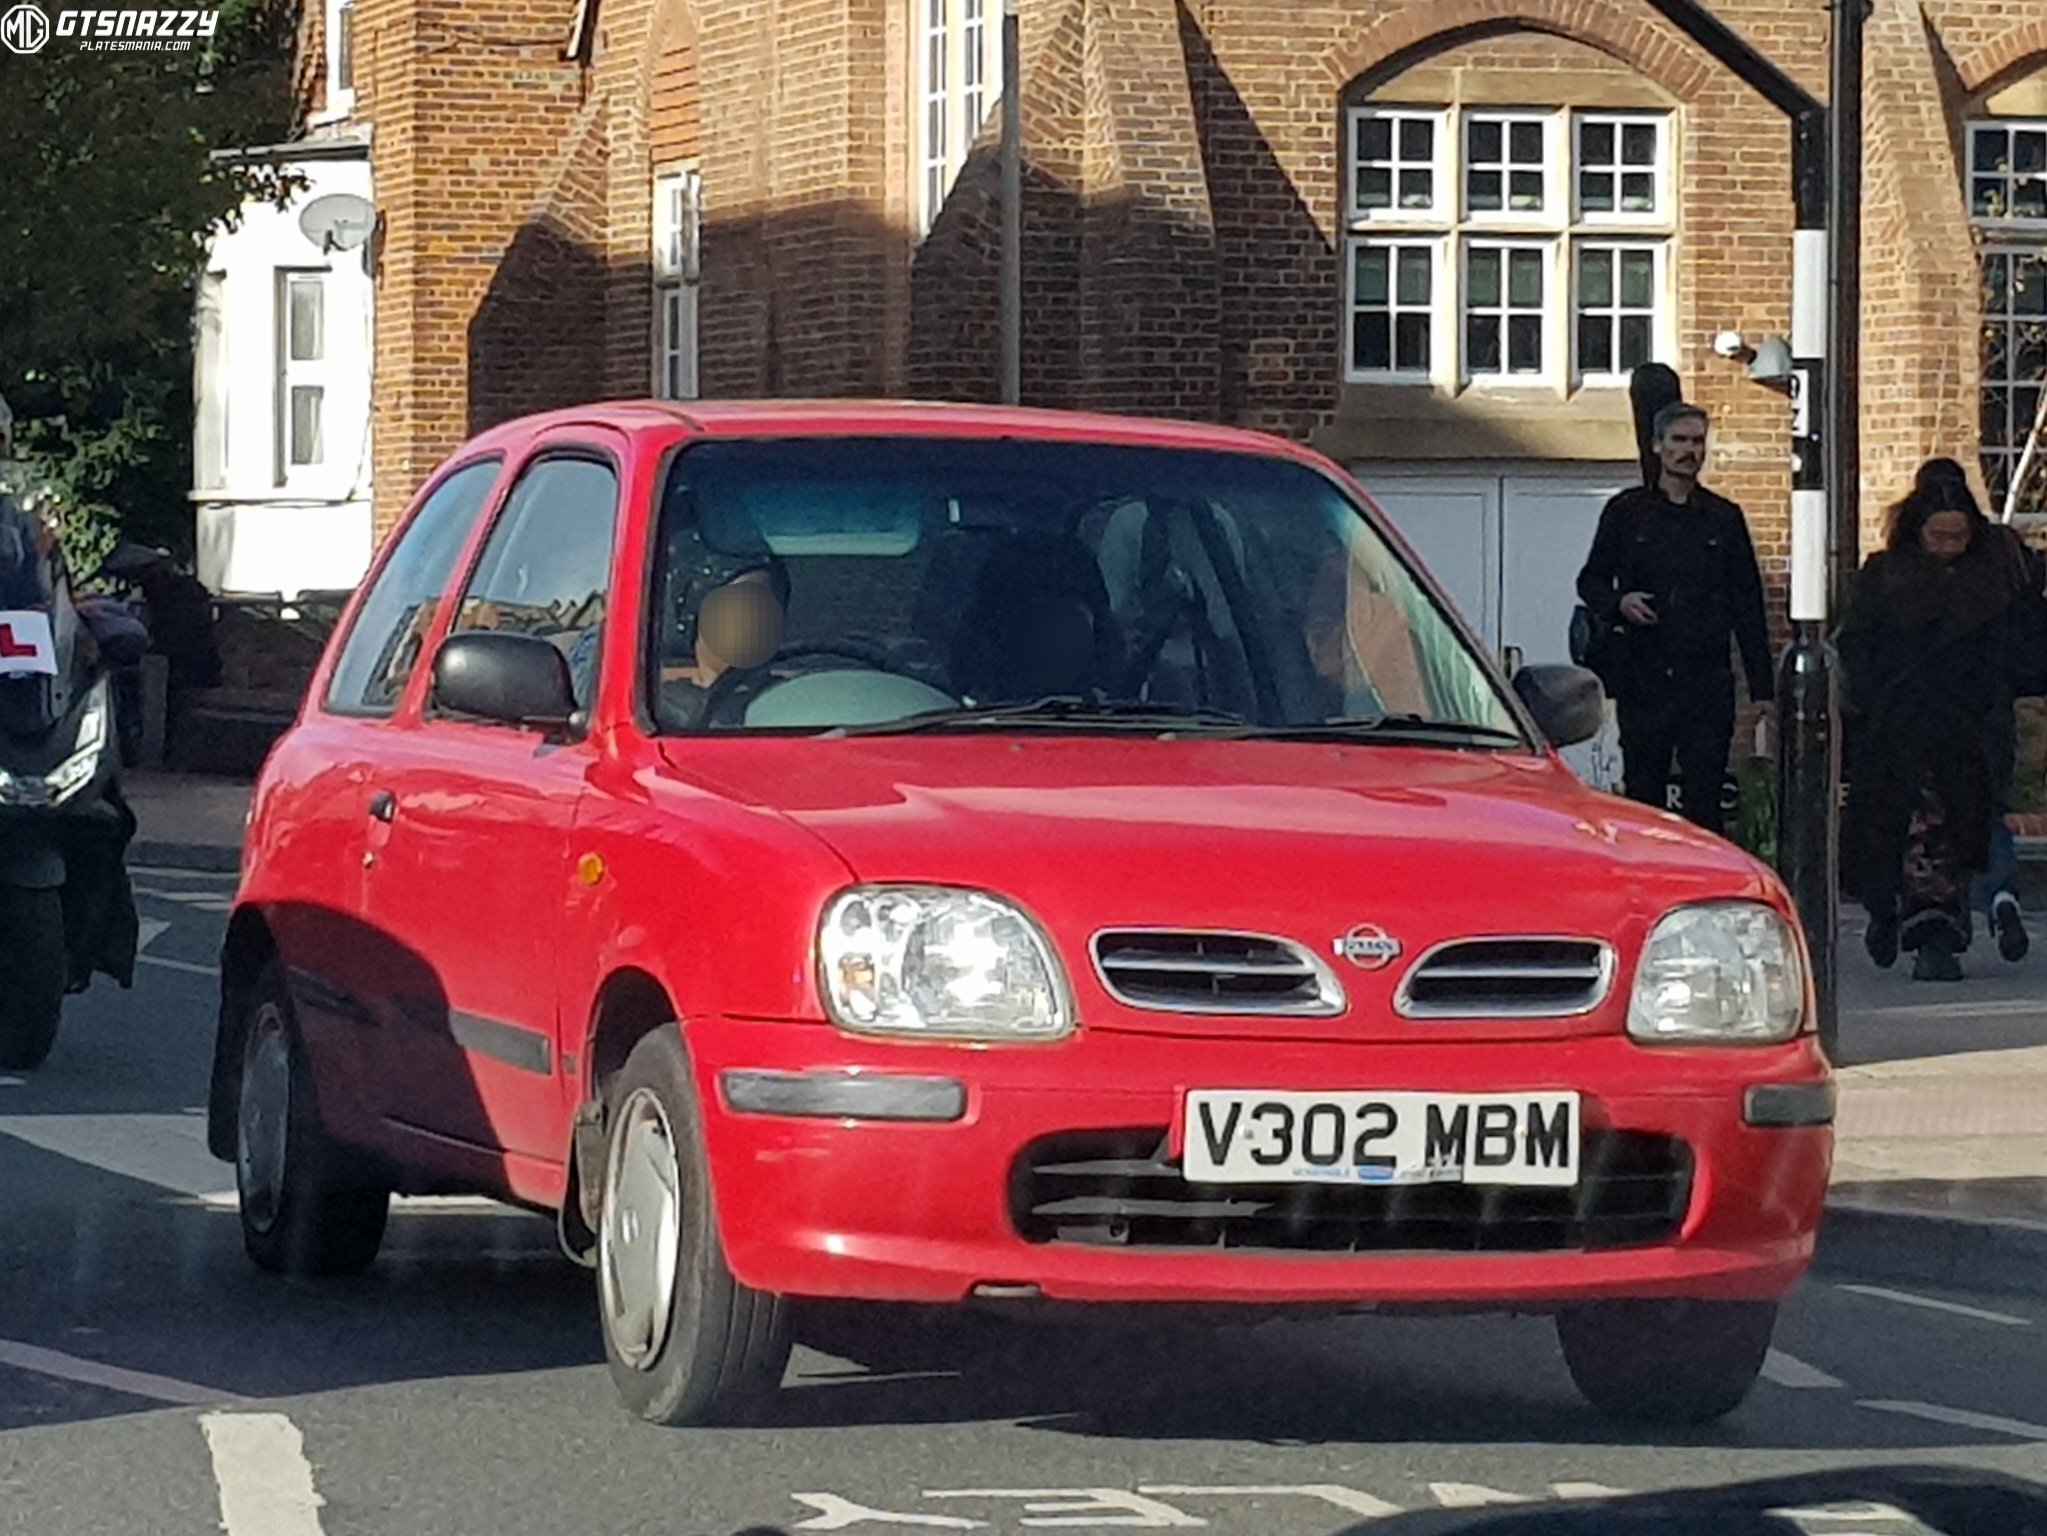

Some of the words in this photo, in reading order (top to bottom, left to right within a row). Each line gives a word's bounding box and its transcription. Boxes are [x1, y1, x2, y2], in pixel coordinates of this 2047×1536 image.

[0, 623, 37, 657] L
[1198, 1101, 1398, 1167] V302
[1426, 1101, 1570, 1167] MBM
